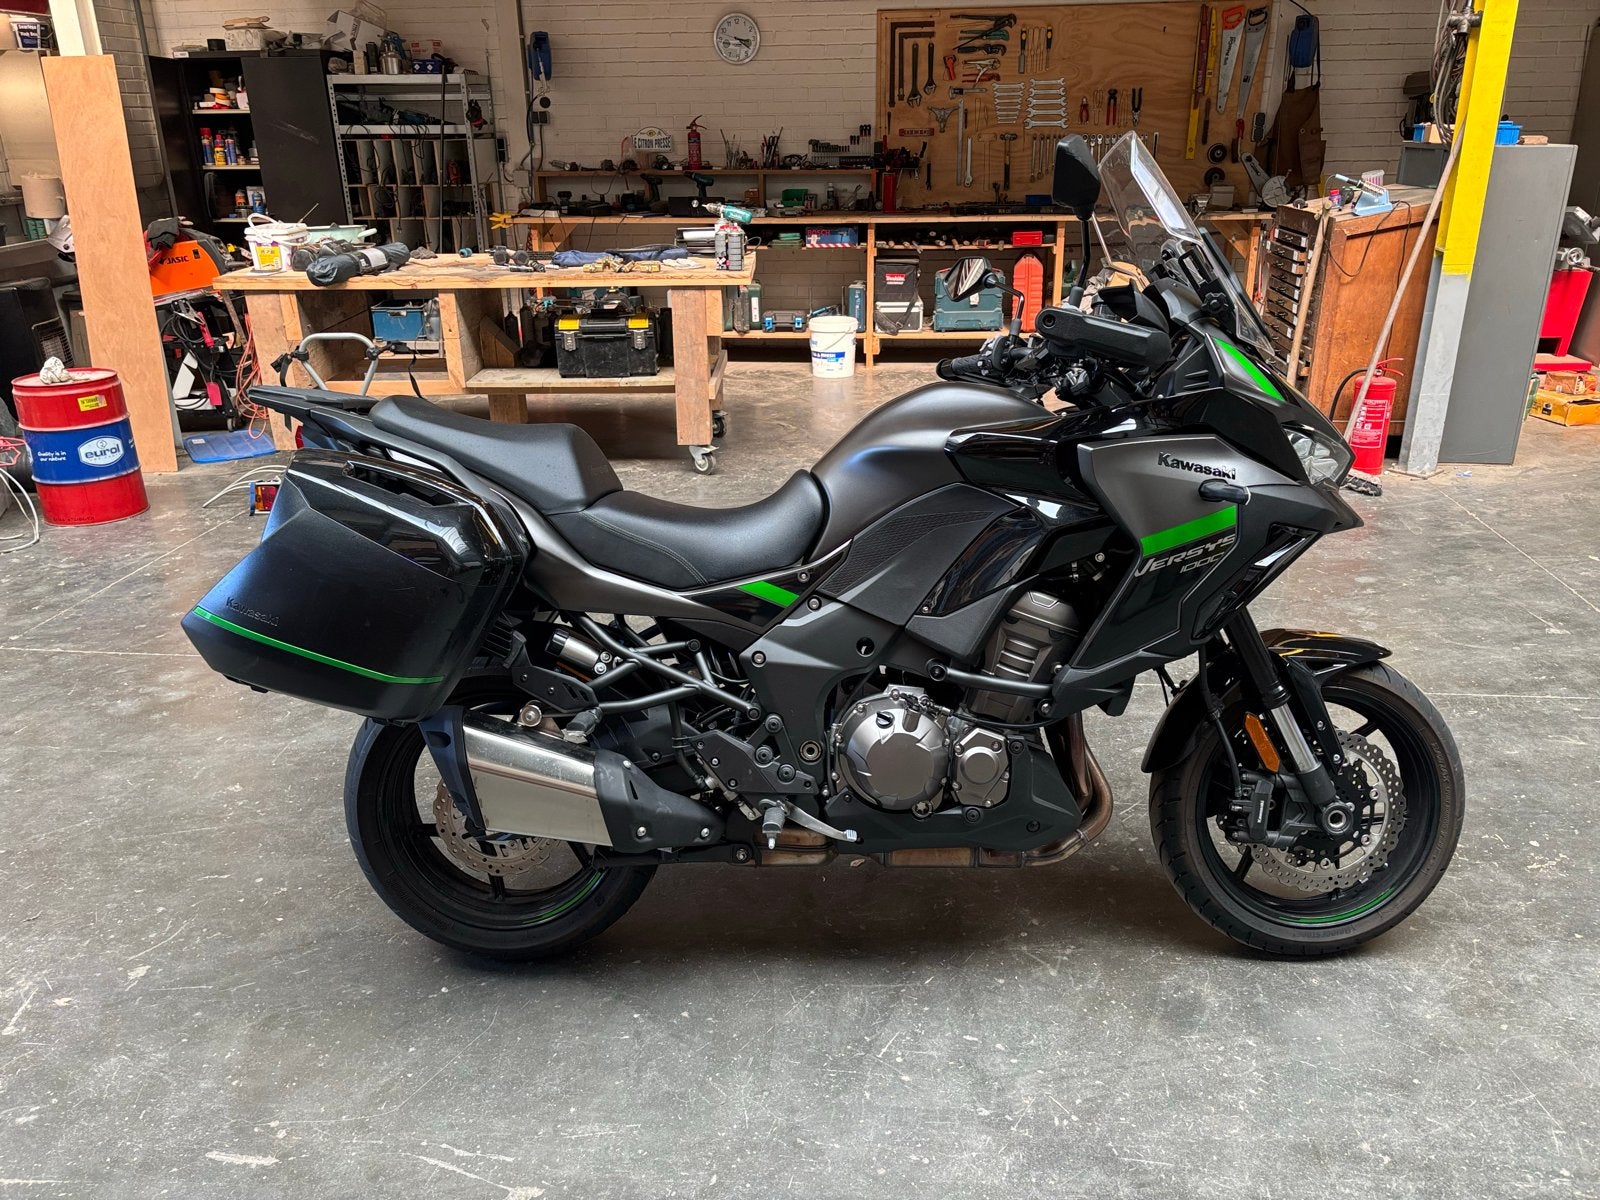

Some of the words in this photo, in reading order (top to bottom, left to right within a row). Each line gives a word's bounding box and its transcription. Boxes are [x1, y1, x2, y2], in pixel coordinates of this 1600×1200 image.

[166, 255, 189, 265] JASIC
[84, 444, 120, 459] eurol
[1157, 452, 1237, 480] Kawasaki
[225, 596, 280, 627] Kawasaki
